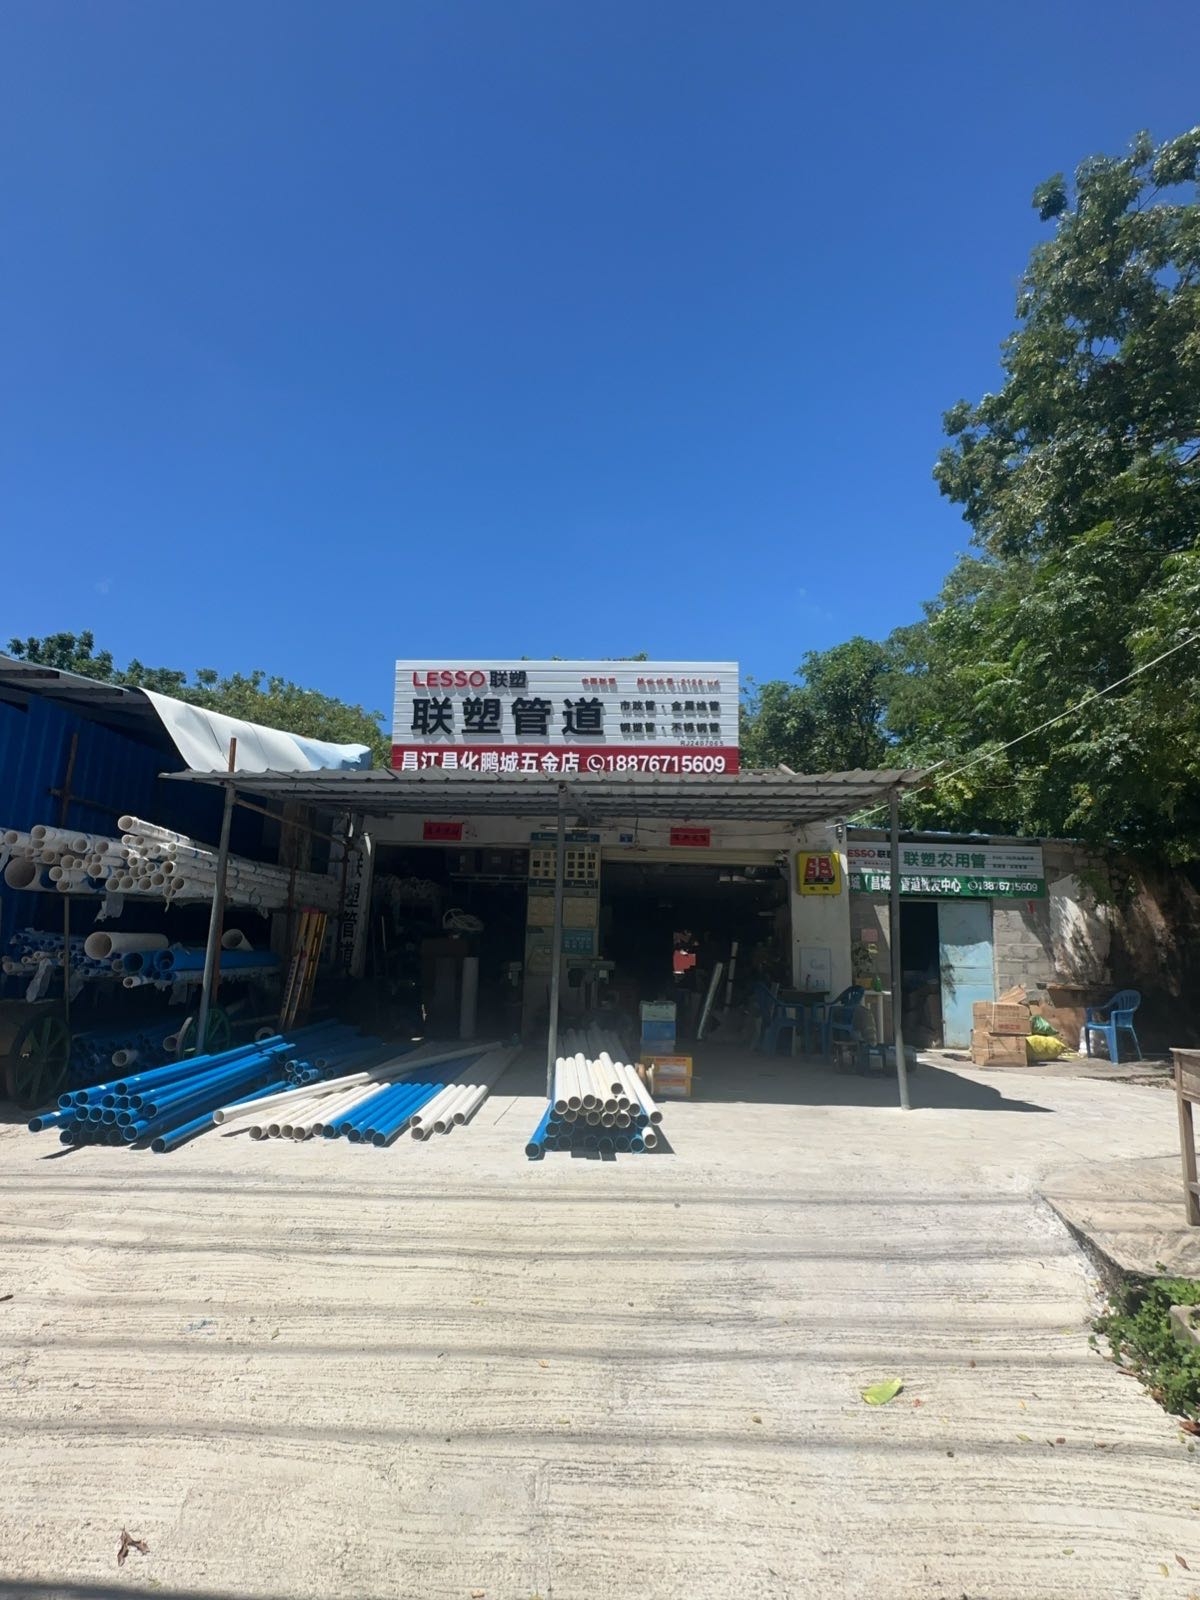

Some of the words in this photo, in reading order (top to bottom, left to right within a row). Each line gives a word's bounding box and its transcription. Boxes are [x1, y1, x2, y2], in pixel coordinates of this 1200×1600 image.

[413, 671, 486, 688] LESSO
[490, 671, 526, 688] 联塑
[411, 697, 604, 736] 联塑管道
[402, 751, 580, 773] 昌江昌化鹏城五金店
[607, 755, 726, 773] 18876715609
[847, 849, 876, 858] ESSO
[903, 851, 986, 869] 联塑农用管
